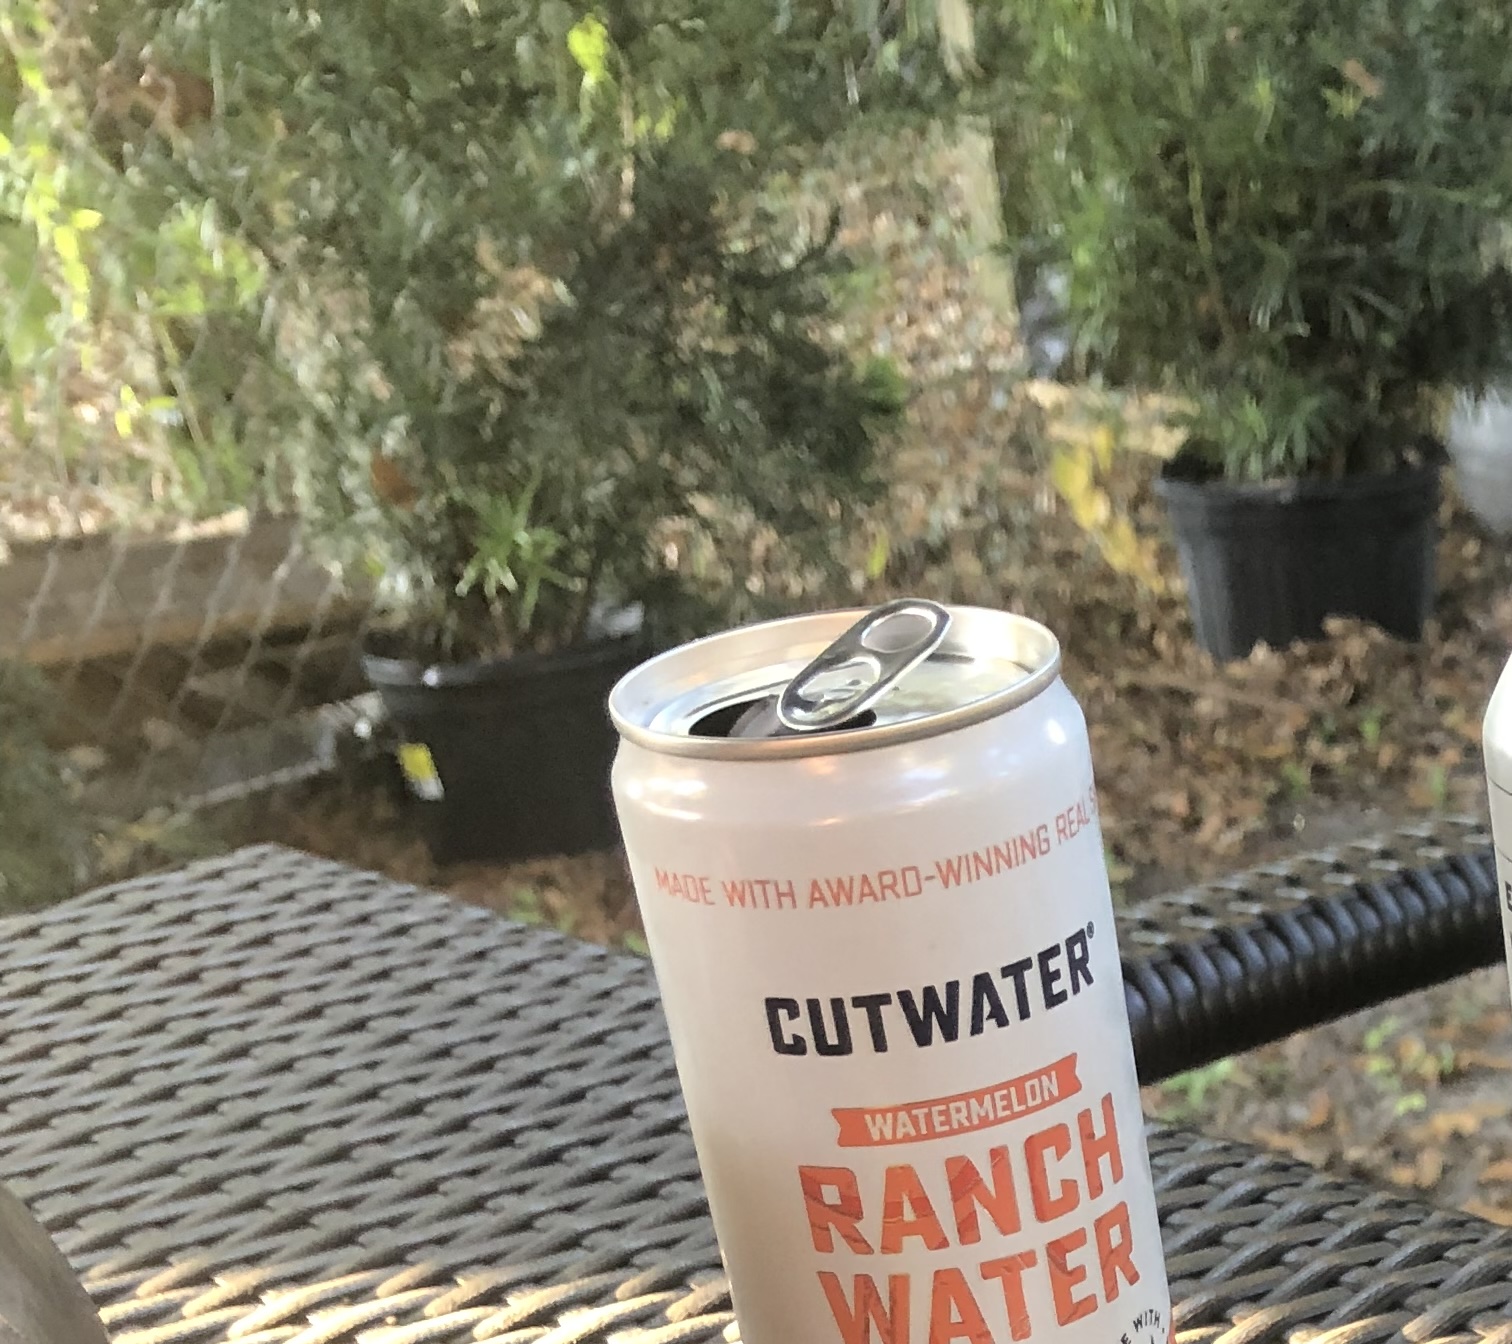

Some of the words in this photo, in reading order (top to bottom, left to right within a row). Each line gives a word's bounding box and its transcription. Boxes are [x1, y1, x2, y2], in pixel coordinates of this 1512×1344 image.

[653, 866, 716, 906] MADE
[721, 879, 797, 910] WITH
[808, 824, 1051, 910] AWARD-WINNING
[1055, 795, 1090, 846] REAL
[863, 1070, 1060, 1142] WATERMELON
[798, 1092, 1125, 1255] RANCH
[1133, 1309, 1161, 1333] WITH
